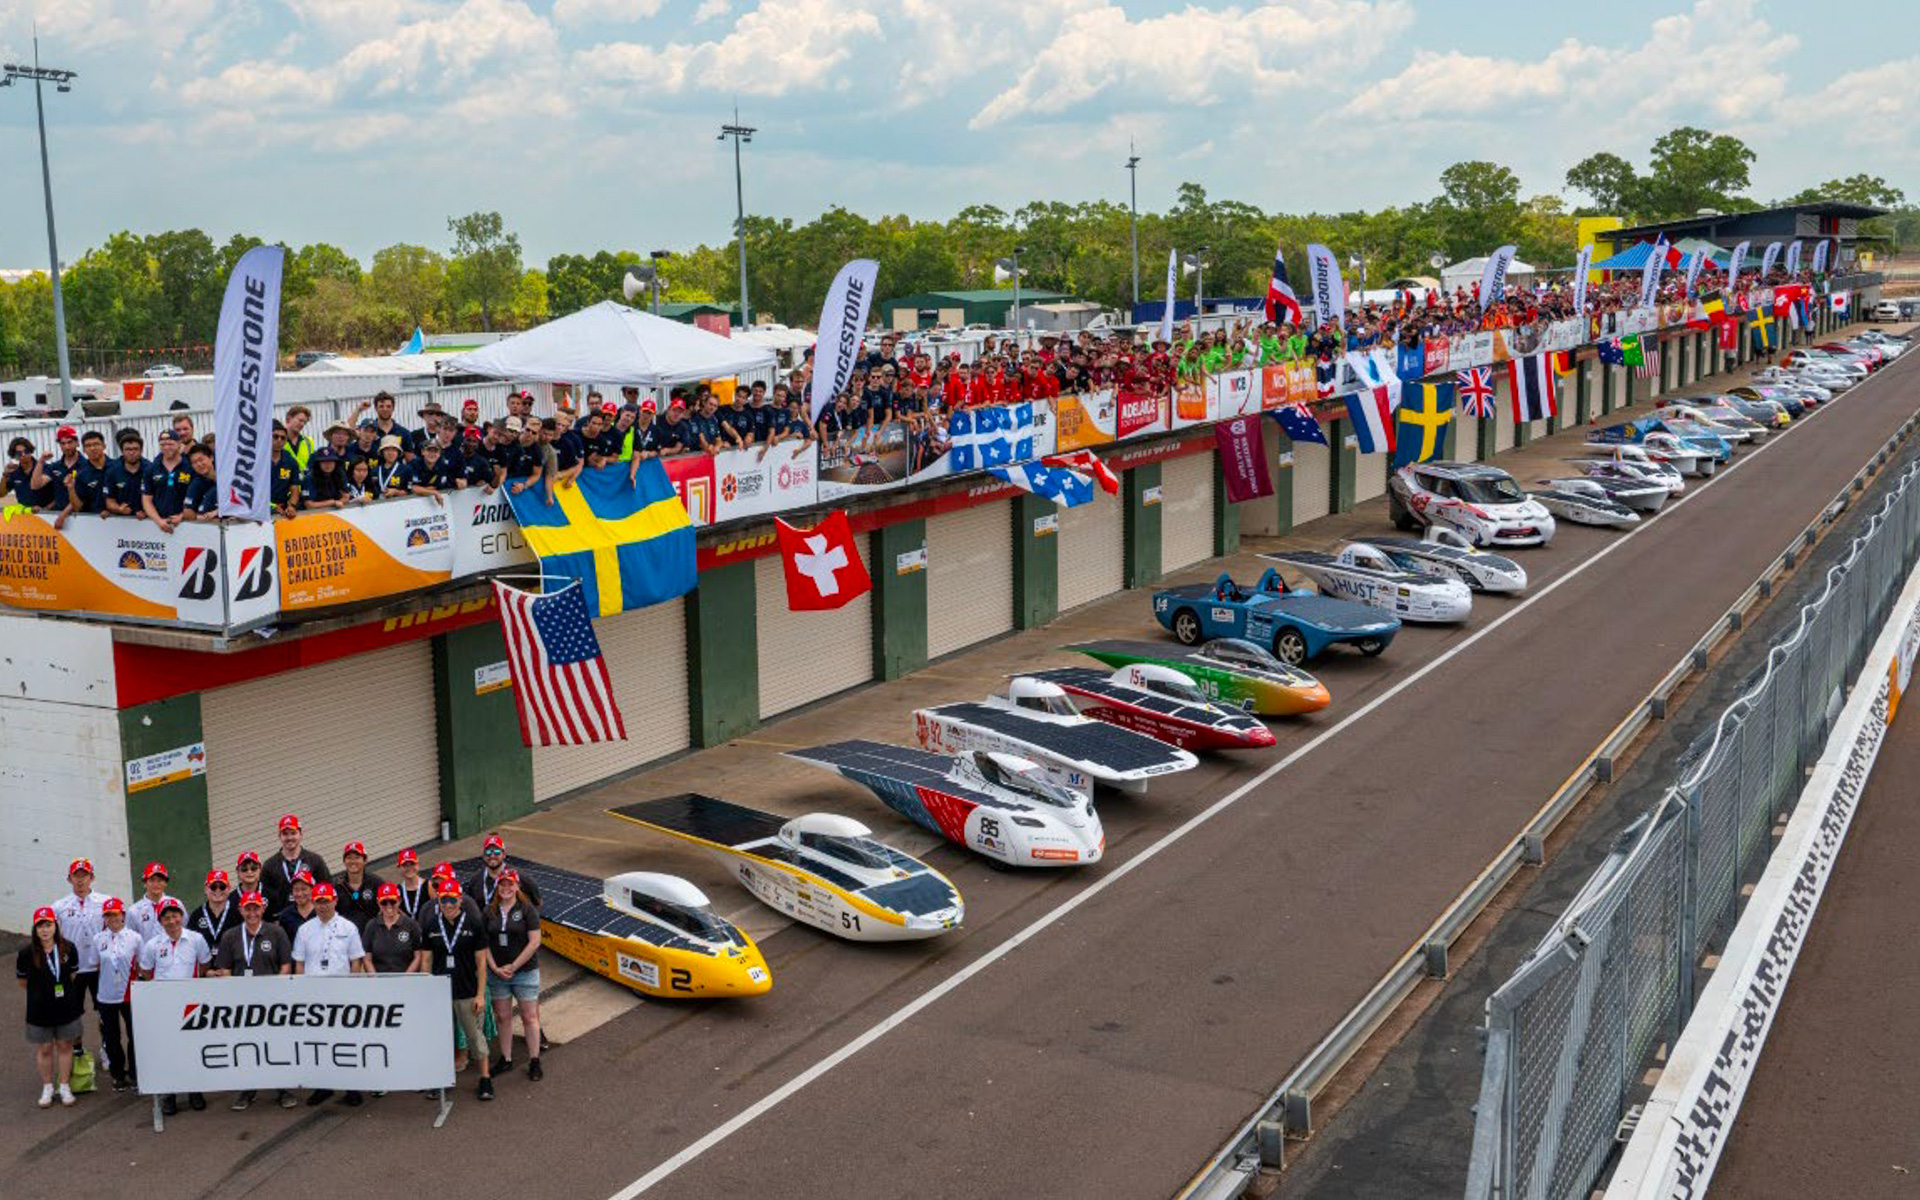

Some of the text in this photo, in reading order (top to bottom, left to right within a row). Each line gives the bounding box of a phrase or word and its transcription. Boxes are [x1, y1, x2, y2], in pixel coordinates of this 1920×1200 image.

[1315, 256, 1330, 325] BRIDGEST
[831, 276, 864, 402] IDGESTONE
[230, 275, 265, 511] BRIDGESTONE
[284, 528, 355, 553] BRIDGESTONE
[28, 550, 60, 565] SOLAR
[286, 544, 357, 569] WORLD SOLAR
[287, 561, 346, 585] CHALLENGE
[841, 911, 862, 933] 51
[671, 968, 693, 993] 2
[181, 1003, 405, 1031] BRIDGESTONE
[201, 1041, 389, 1069] ENLITEN
